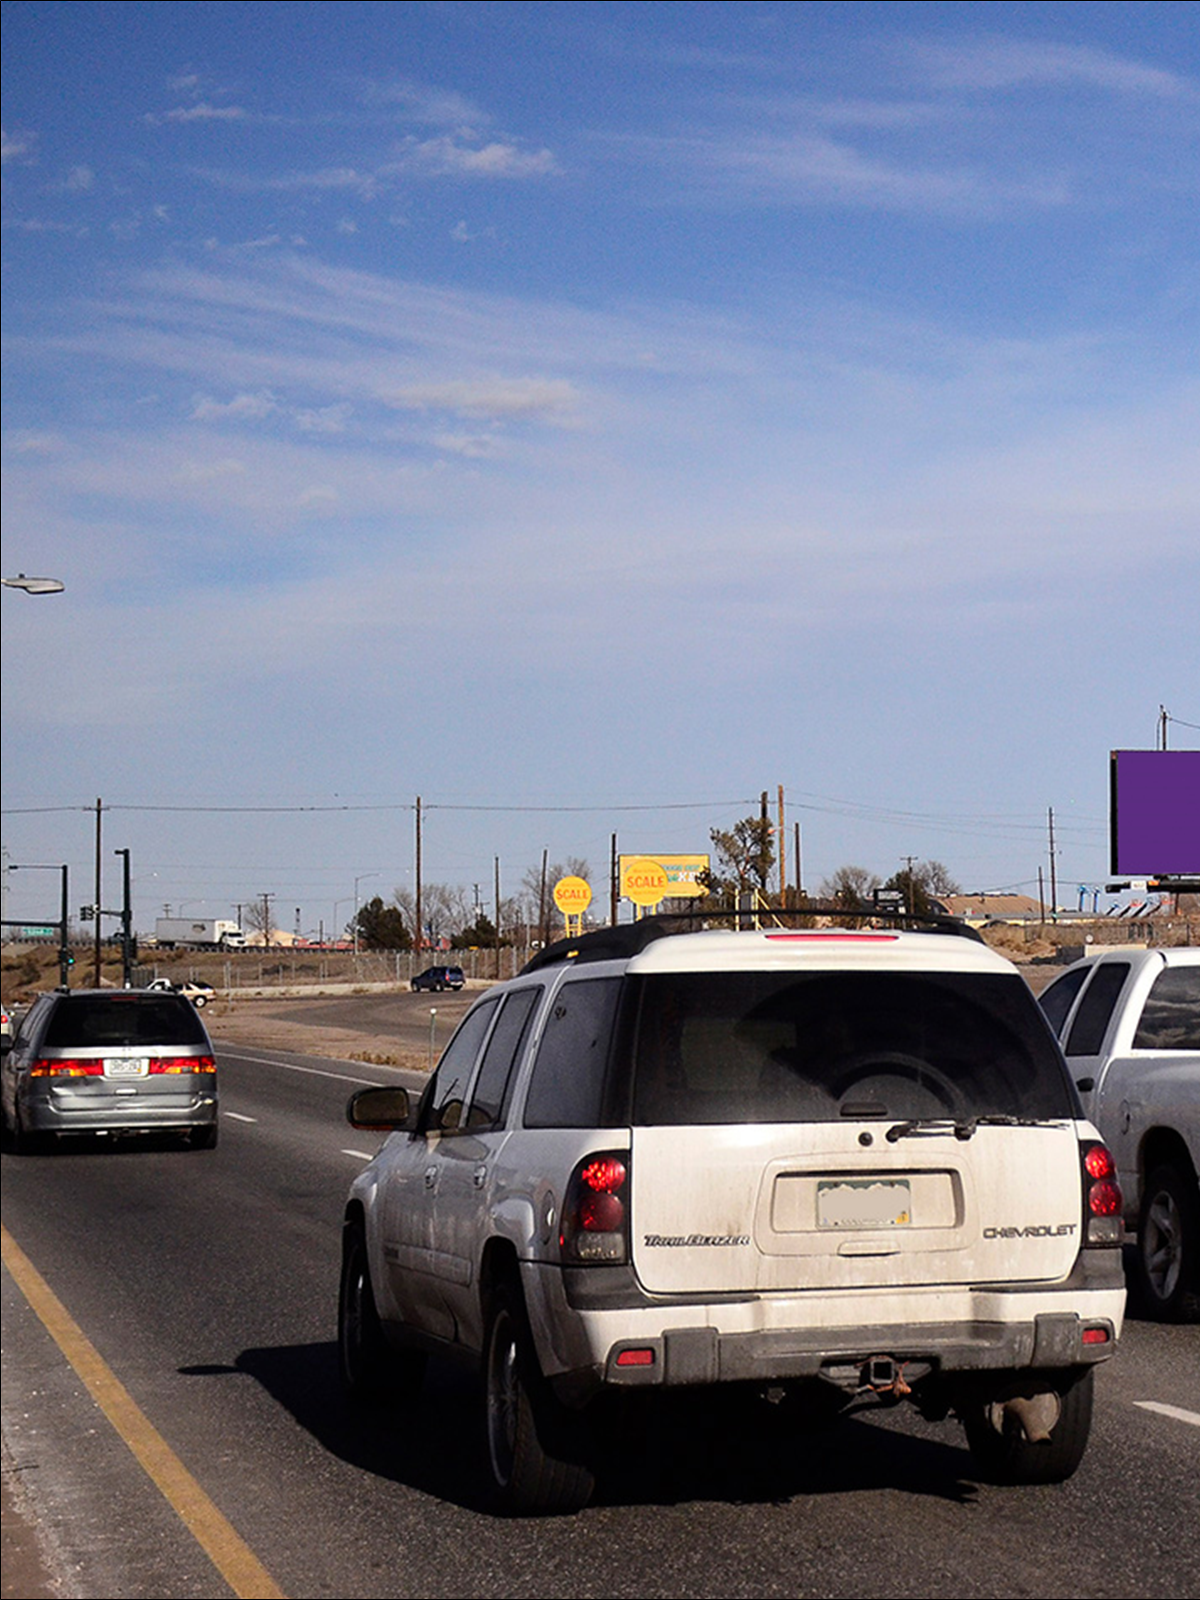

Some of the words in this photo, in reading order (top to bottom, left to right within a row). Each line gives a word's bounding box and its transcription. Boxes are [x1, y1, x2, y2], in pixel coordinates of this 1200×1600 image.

[627, 876, 665, 888] SCALE
[556, 889, 589, 900] SCALE
[983, 1224, 1077, 1239] CHEVROLET
